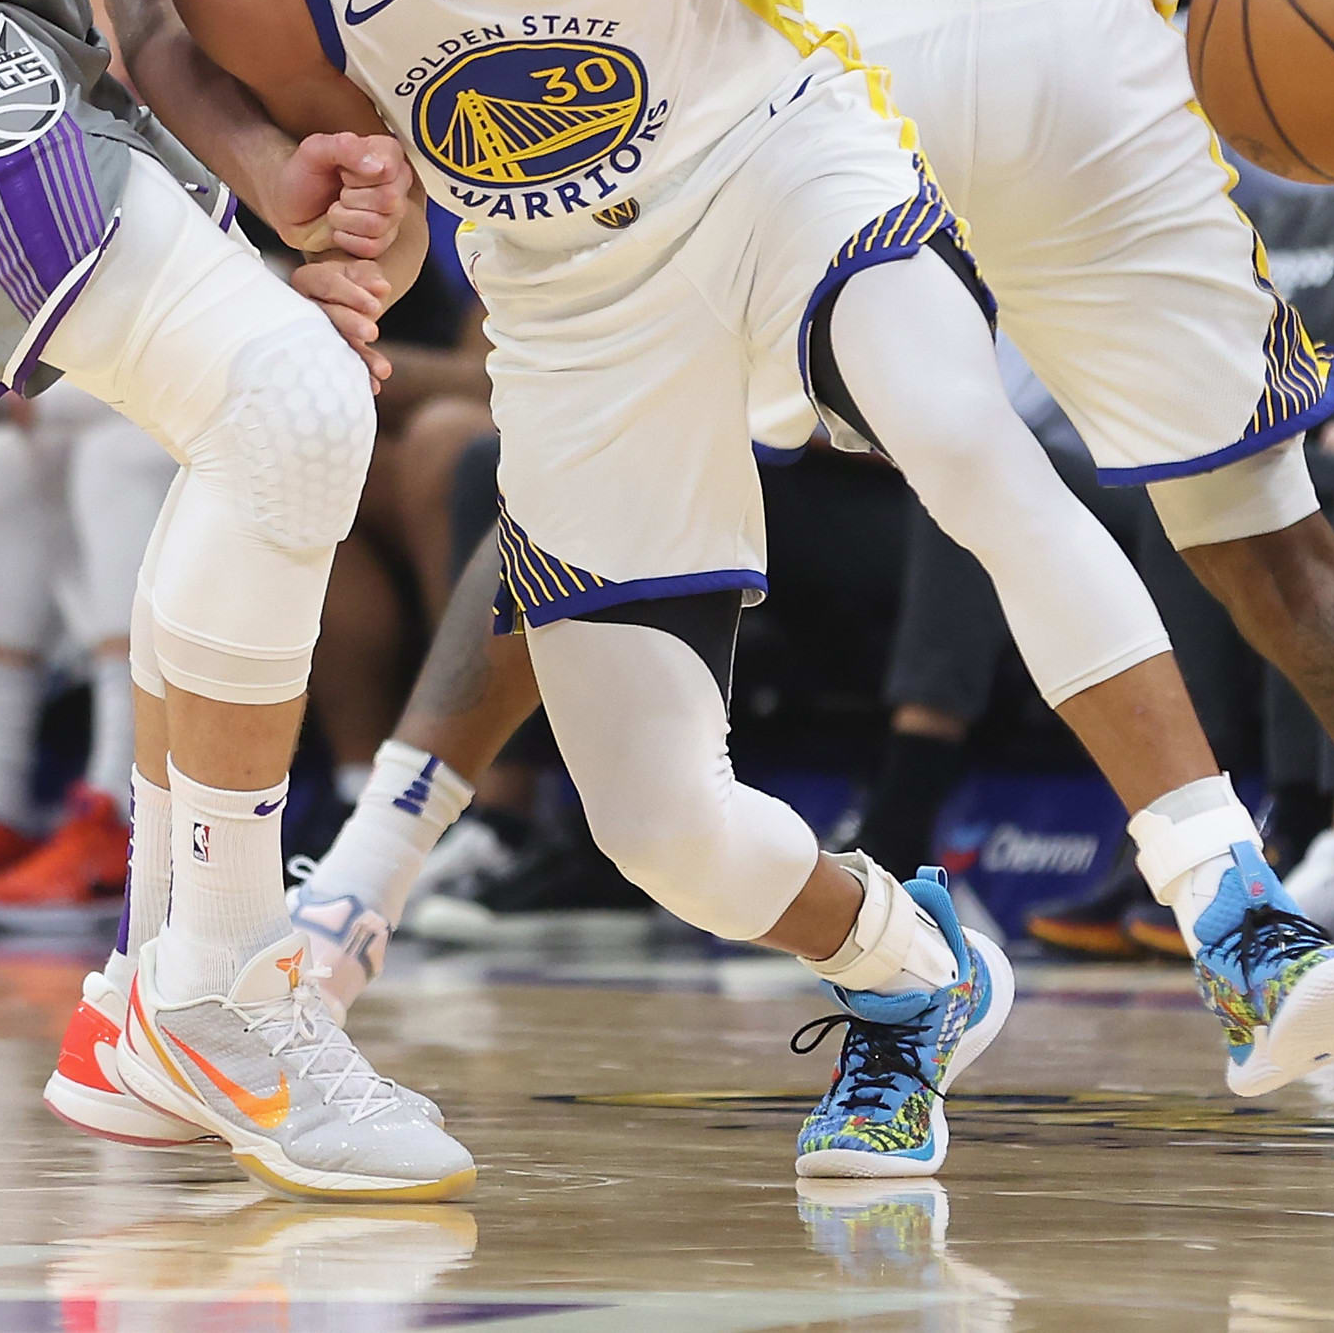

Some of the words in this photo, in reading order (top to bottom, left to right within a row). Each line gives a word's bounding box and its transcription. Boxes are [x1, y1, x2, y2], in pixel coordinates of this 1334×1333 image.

[394, 23, 505, 97] GOLDEN
[523, 15, 620, 39] STATE
[529, 56, 618, 105] 30
[450, 98, 668, 221] WARRIORS
[983, 823, 1100, 874] Chevron
